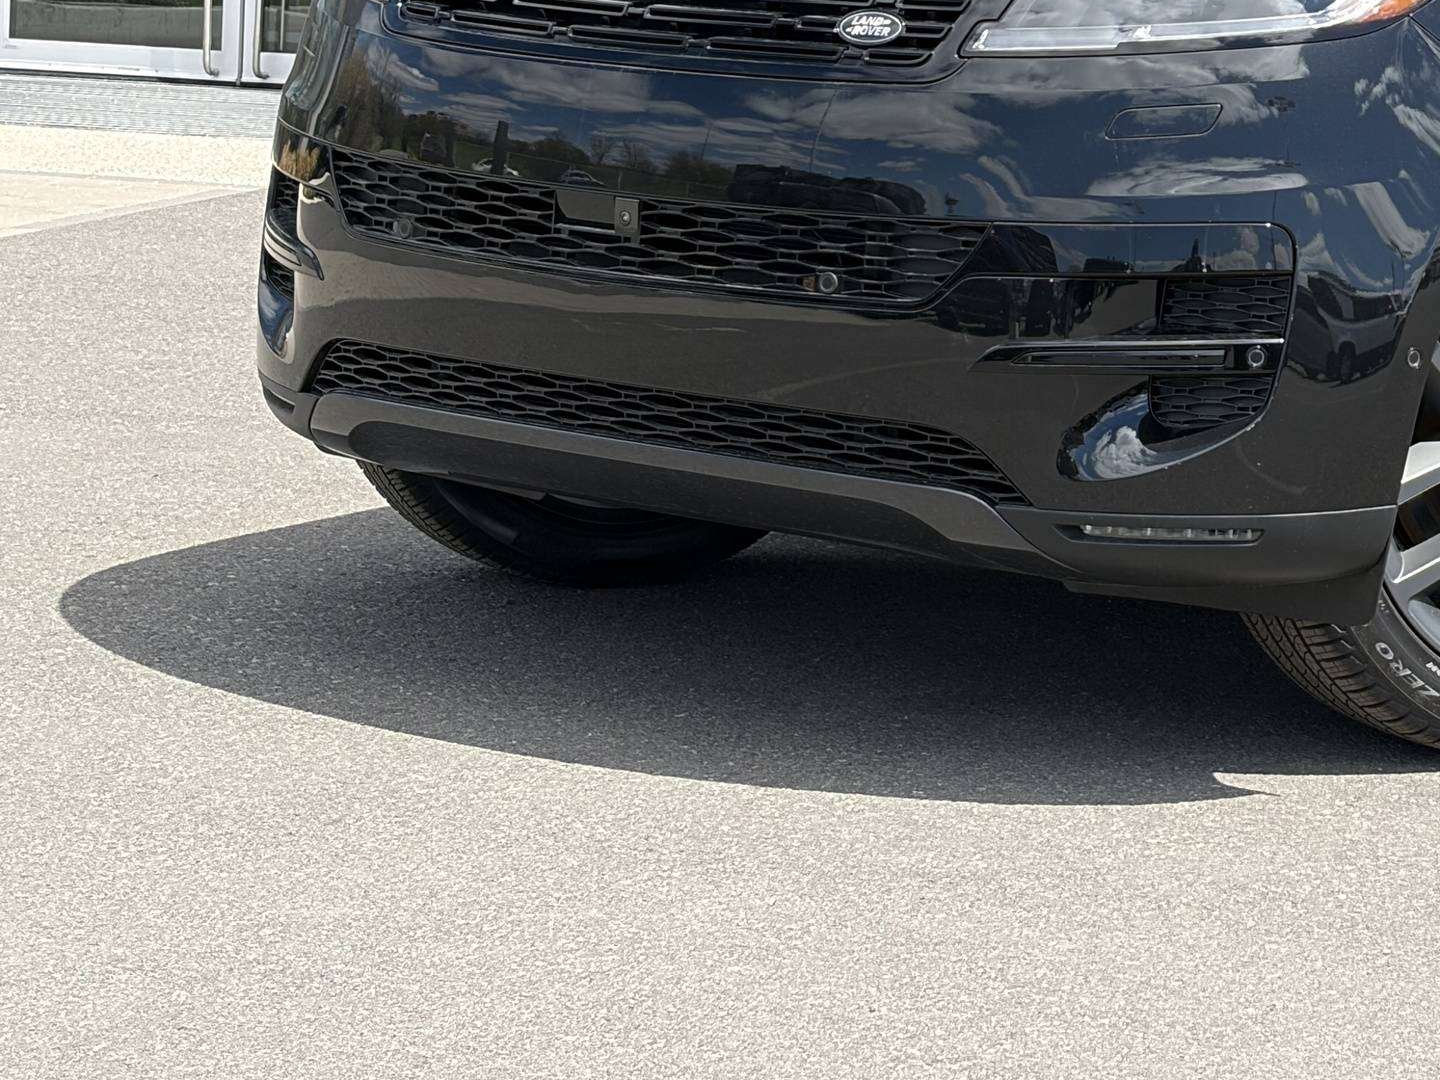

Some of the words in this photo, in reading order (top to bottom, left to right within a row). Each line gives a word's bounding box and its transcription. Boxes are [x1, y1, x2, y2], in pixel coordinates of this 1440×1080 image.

[851, 15, 885, 26] LAND
[850, 25, 891, 36] ROVER
[1374, 642, 1440, 698] ZERO
